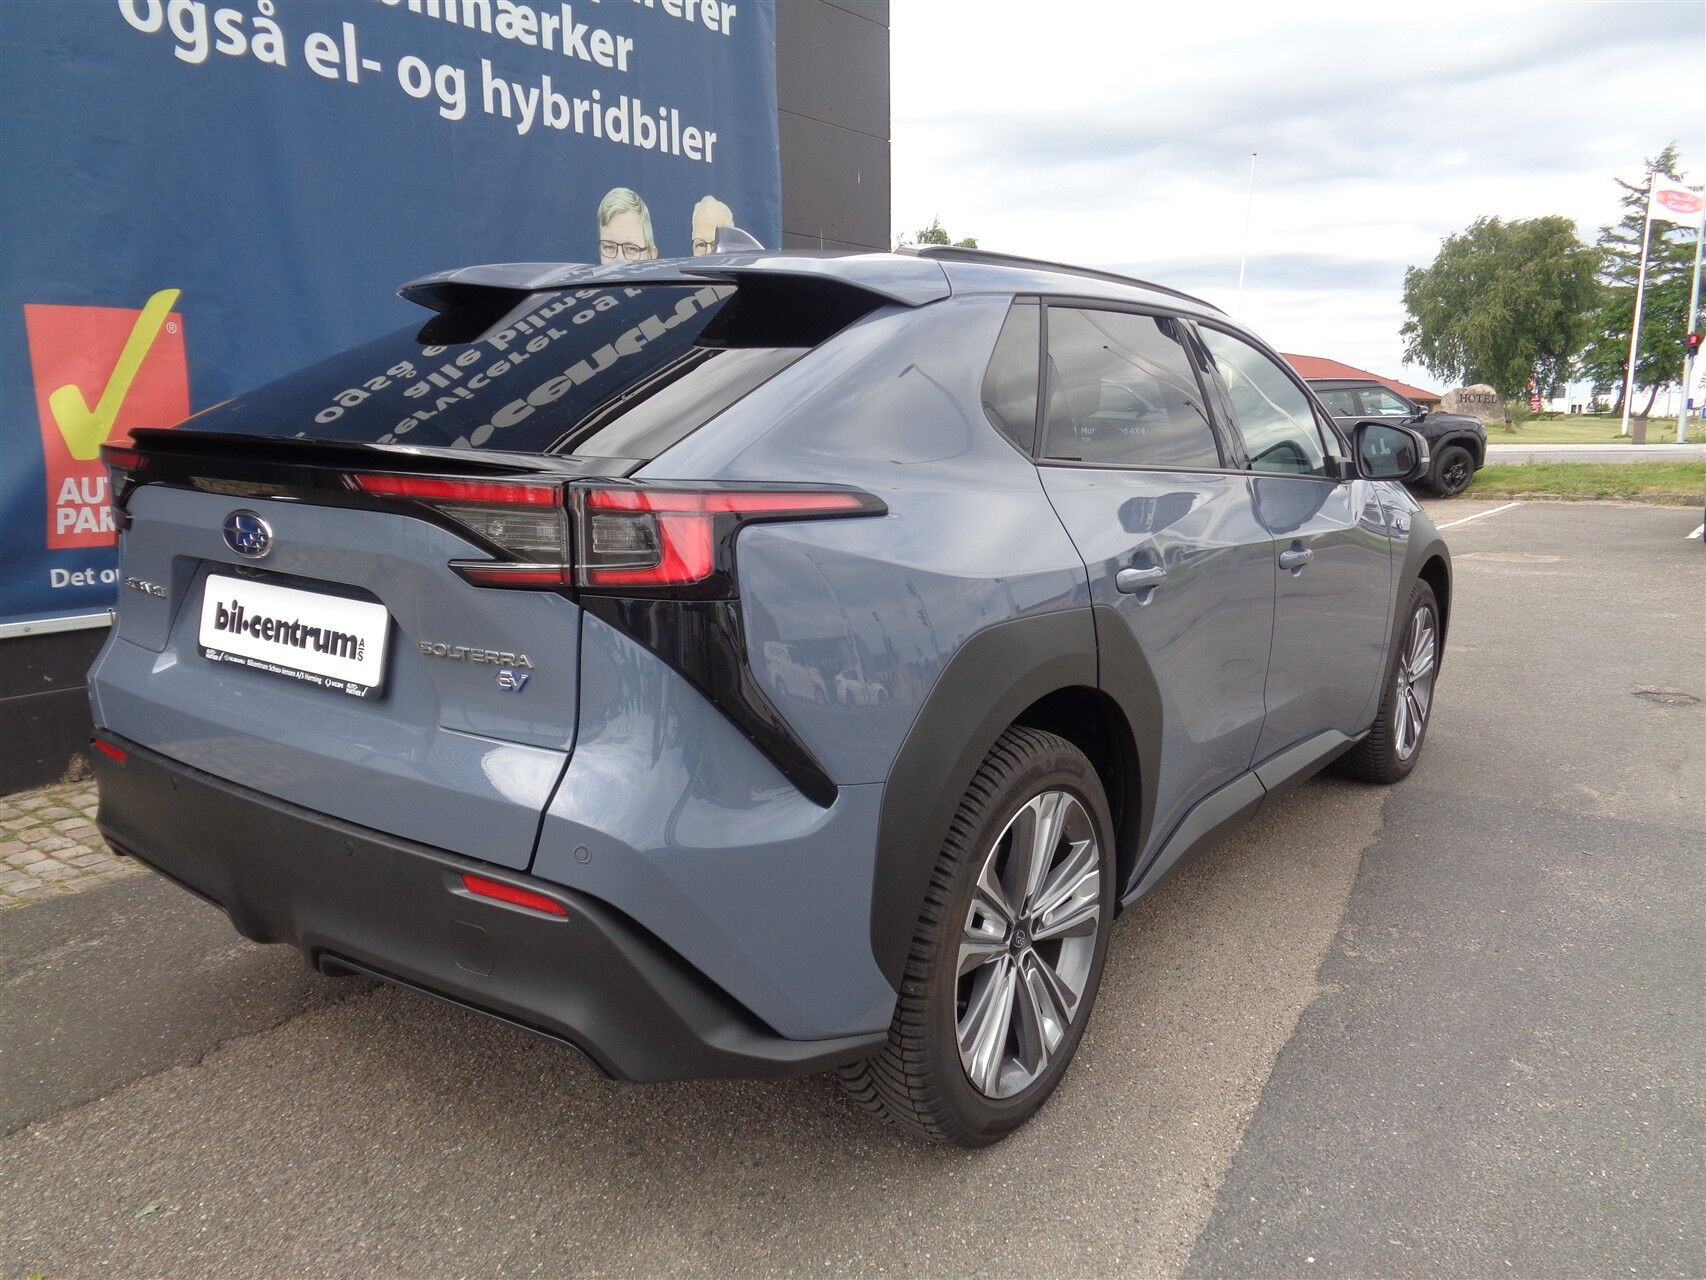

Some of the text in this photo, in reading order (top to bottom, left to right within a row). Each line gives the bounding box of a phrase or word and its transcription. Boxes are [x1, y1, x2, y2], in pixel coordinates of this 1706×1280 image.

[379, 0, 633, 73] mærker
[118, 0, 717, 163] også el- og hybridbiler
[1460, 393, 1498, 404] HOTEL
[56, 477, 108, 505] AU
[50, 568, 95, 588] Det
[418, 641, 535, 671] SOLTERRA
